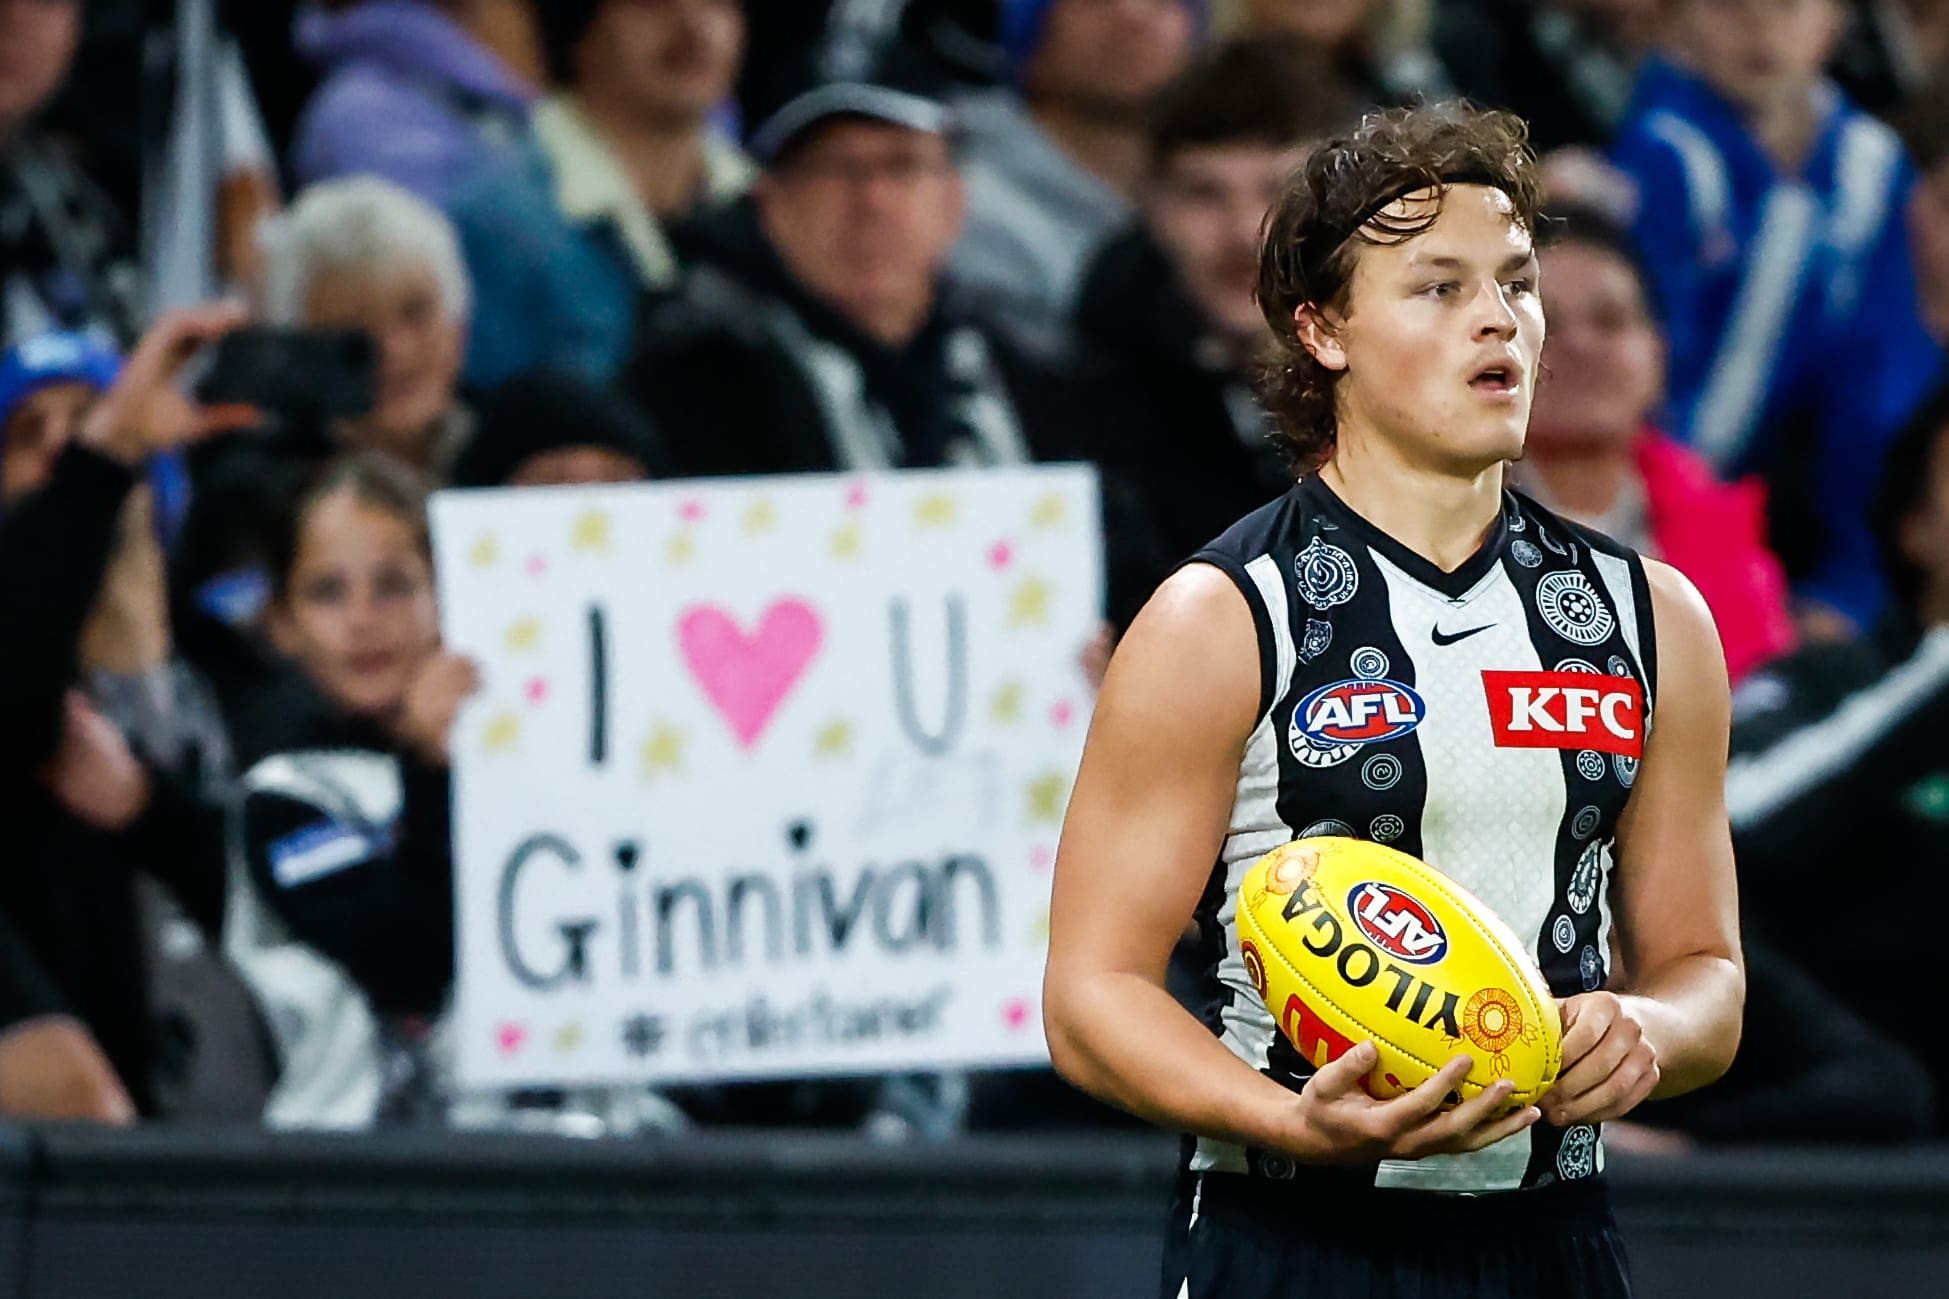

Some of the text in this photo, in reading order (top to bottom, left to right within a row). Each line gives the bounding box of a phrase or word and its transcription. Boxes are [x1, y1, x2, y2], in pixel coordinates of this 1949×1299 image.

[587, 593, 966, 766] I U
[1307, 690, 1418, 734] AFL
[1506, 686, 1635, 740] KFC
[497, 816, 1000, 990] Ginnivan
[1280, 878, 1461, 1039] YILOGA
[1358, 882, 1445, 956] AFL
